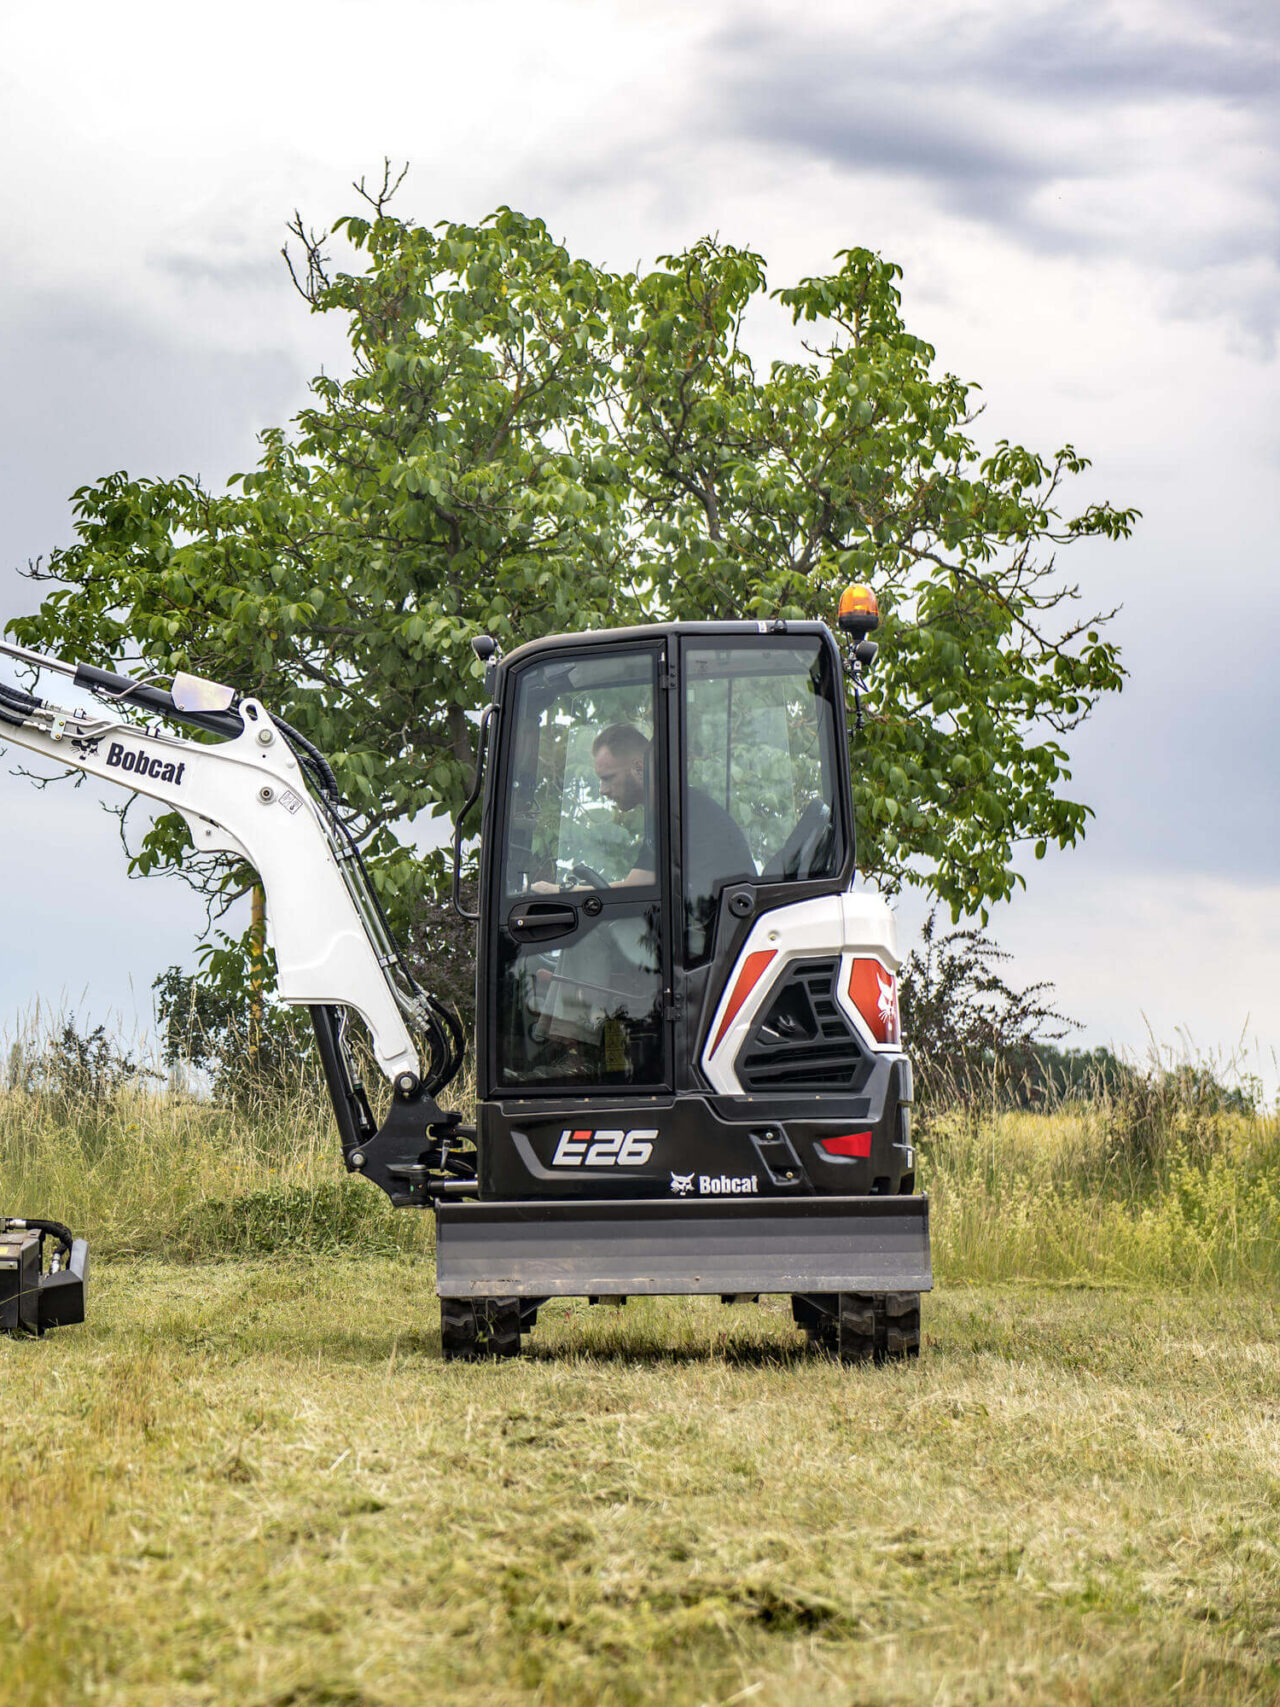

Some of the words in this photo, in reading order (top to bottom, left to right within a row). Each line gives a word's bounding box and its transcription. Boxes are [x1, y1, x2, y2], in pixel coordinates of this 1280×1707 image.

[106, 742, 186, 786] Bobcat
[551, 1129, 660, 1166] E26
[699, 1174, 759, 1194] Bobcat
